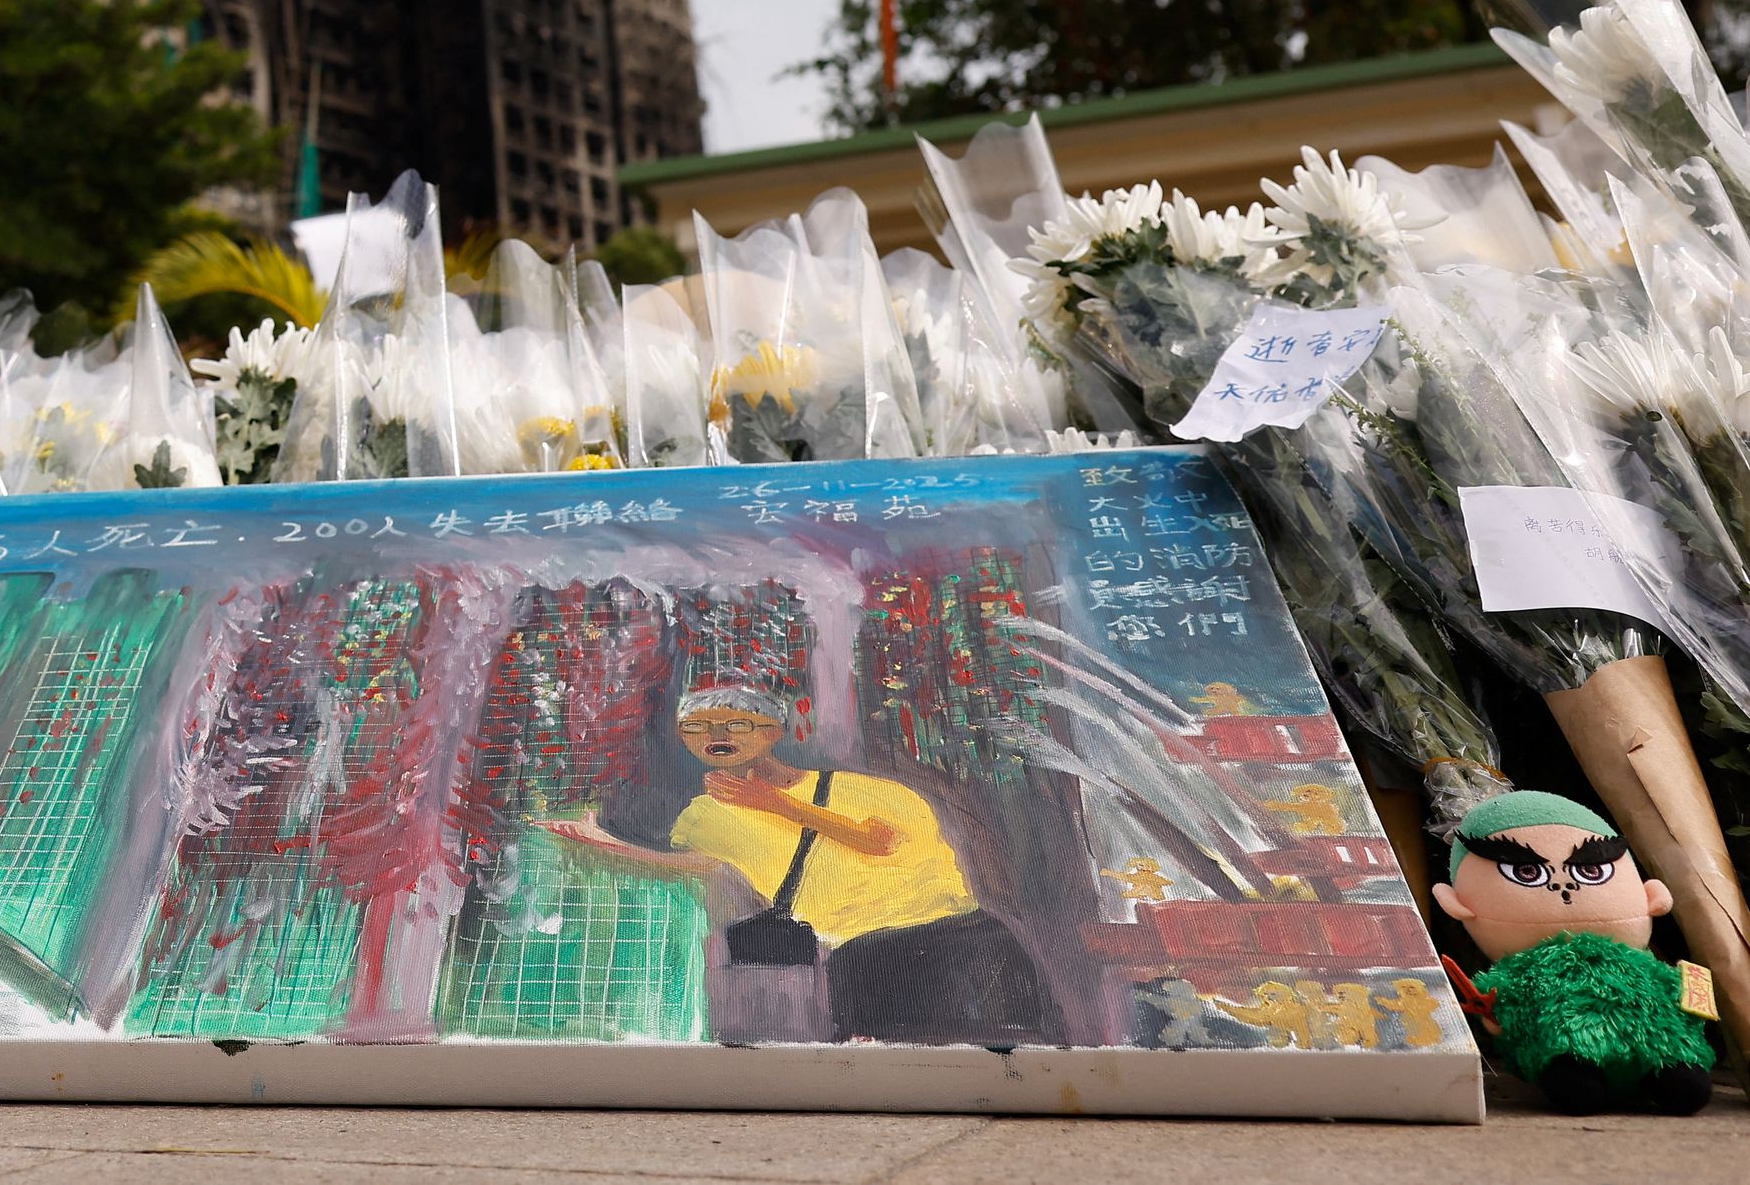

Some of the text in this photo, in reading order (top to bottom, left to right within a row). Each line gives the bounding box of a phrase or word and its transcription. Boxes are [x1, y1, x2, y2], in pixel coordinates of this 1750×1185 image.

[1213, 366, 1355, 403] 天佑香
[740, 494, 941, 525] 宏福苑
[1088, 490, 1208, 513] 大火中
[1084, 542, 1252, 571] 的消防
